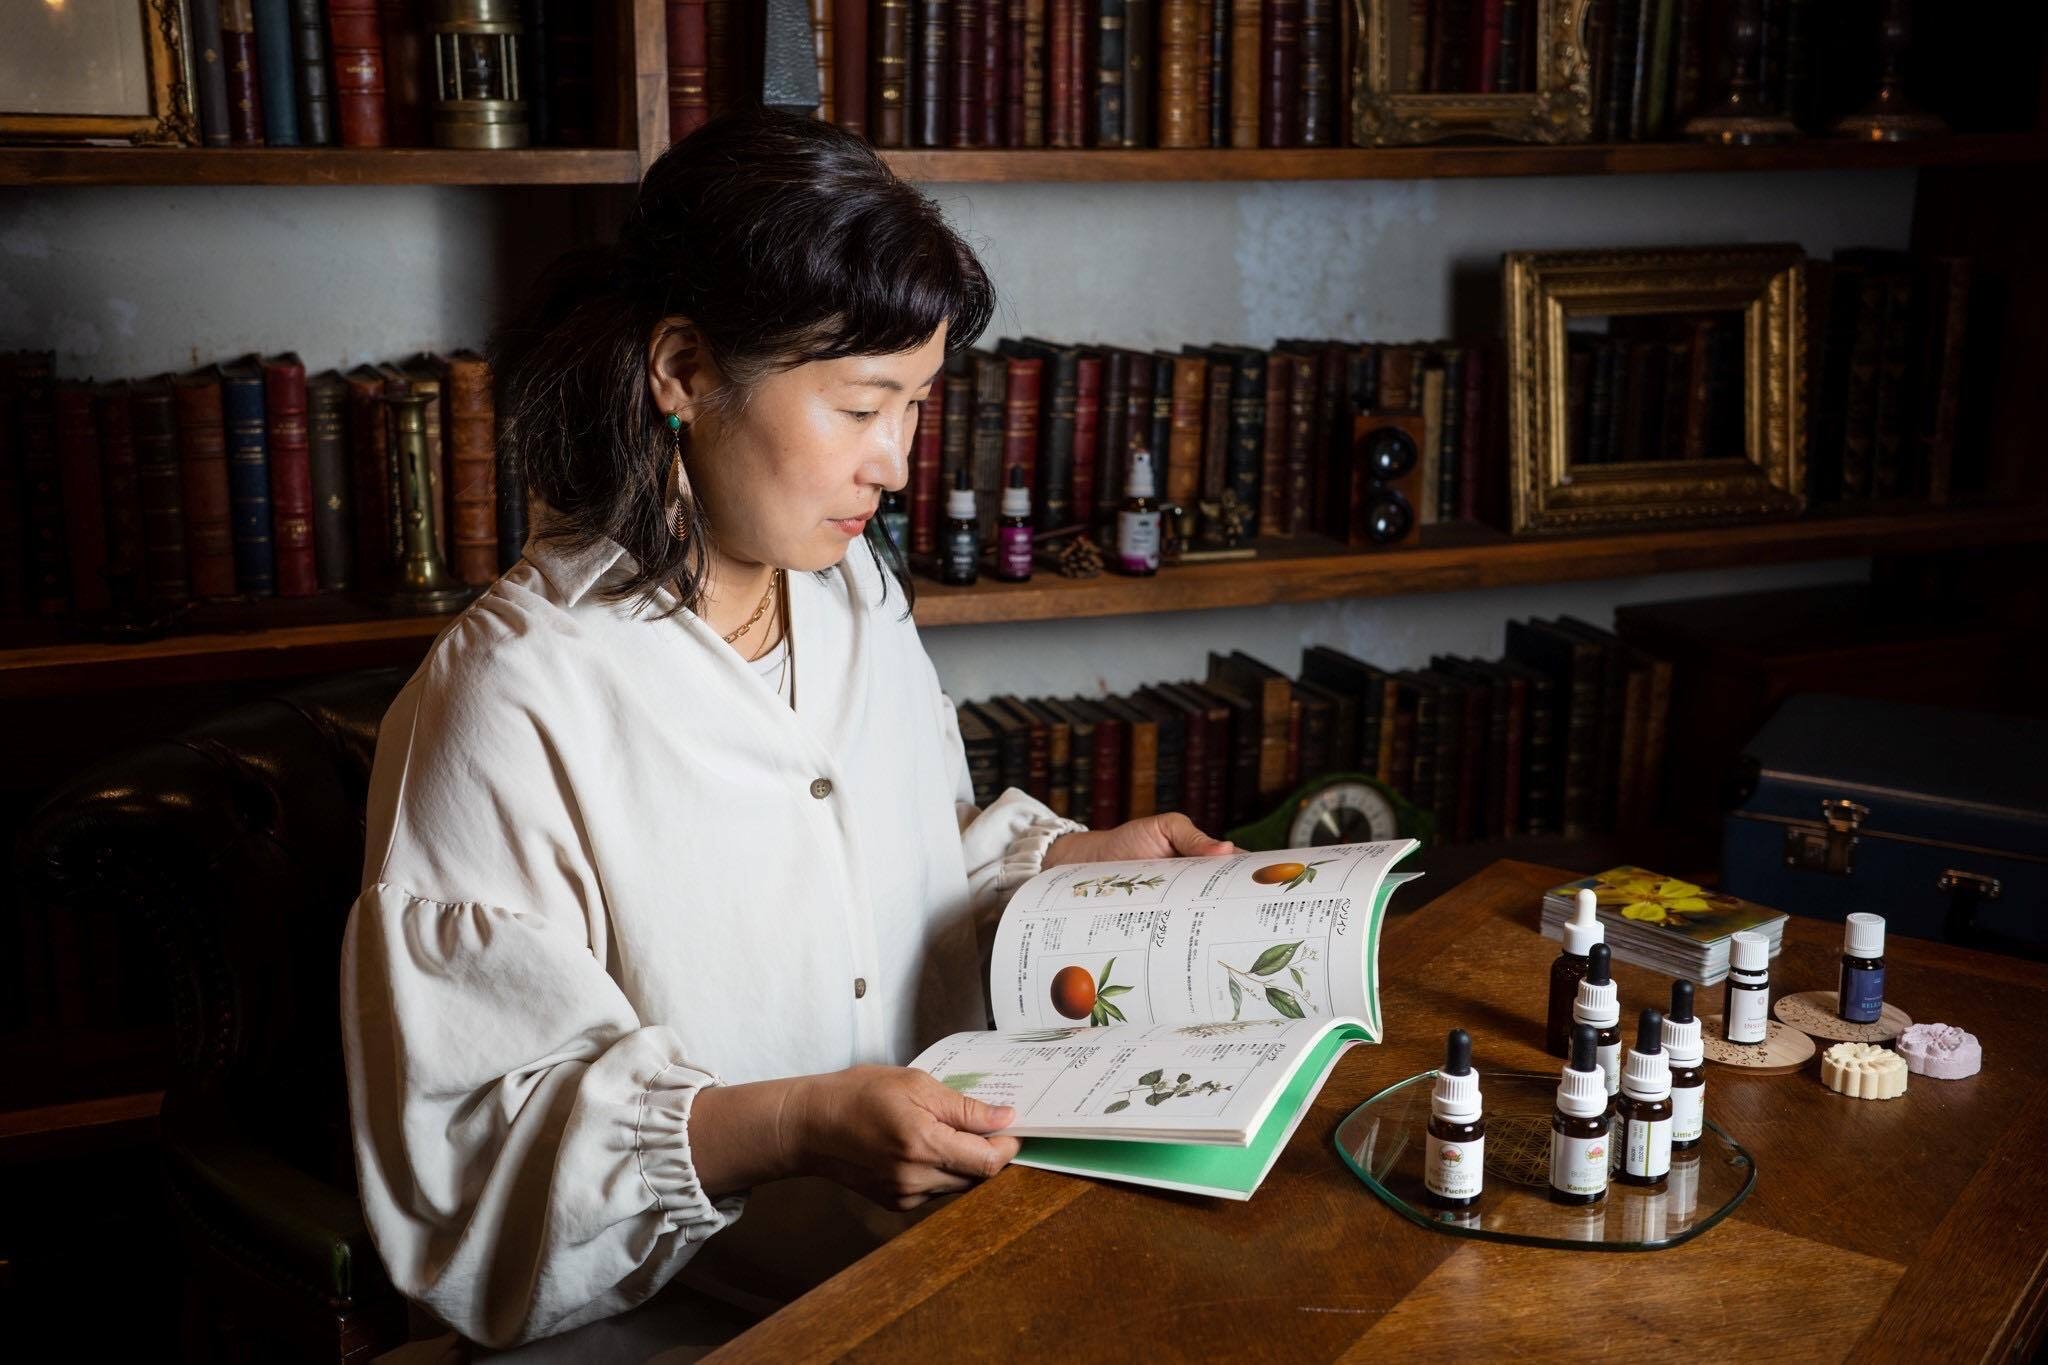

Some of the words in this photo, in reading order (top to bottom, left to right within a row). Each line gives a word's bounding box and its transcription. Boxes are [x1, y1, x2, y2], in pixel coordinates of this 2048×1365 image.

[1155, 909, 1172, 948] マンダリン
[1336, 898, 1351, 936] ベンゾイン
